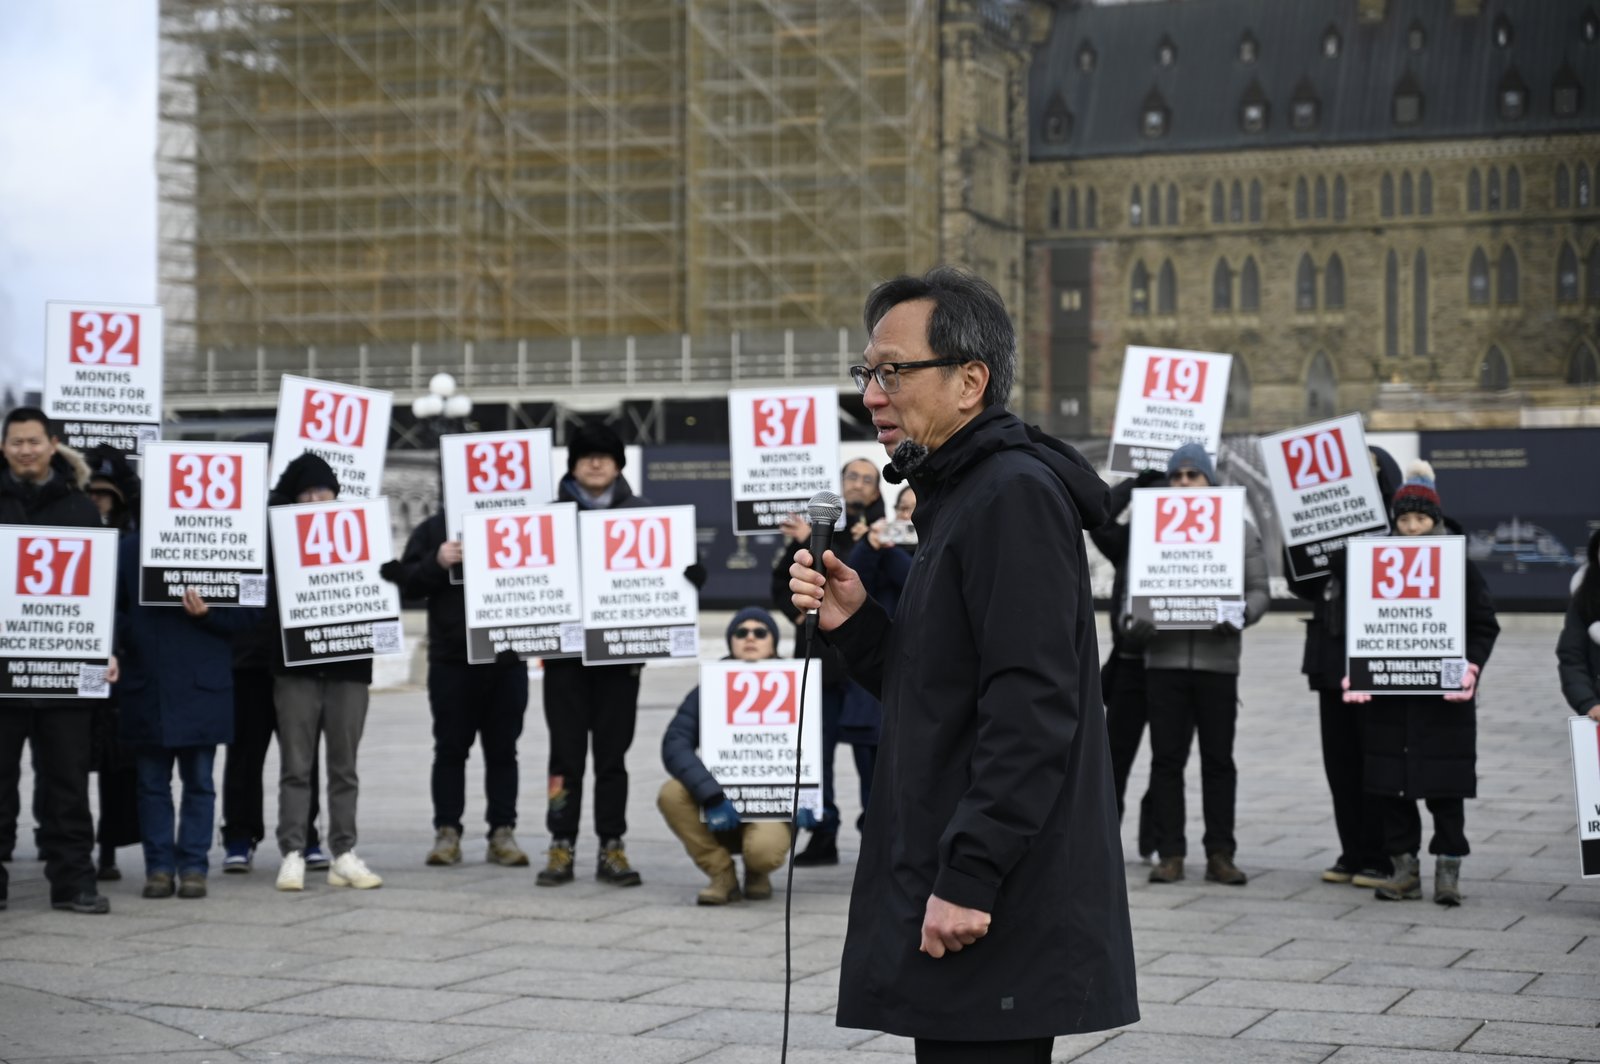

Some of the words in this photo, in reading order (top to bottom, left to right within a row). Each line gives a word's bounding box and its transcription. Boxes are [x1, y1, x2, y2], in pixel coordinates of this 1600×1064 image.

[76, 312, 133, 364] 32
[76, 371, 130, 382] MONTHS
[1149, 359, 1200, 401] 19
[61, 386, 115, 398] WAITING
[121, 388, 144, 399] FOR
[53, 401, 80, 412] IRCC
[84, 403, 152, 415] RESPONSE
[1146, 406, 1194, 417] MONTHS
[306, 391, 362, 446] 30
[760, 399, 810, 446] 37
[1132, 418, 1179, 429] WAITING
[1184, 423, 1205, 431] FOR
[64, 423, 80, 434] NO
[83, 424, 139, 436] TIMELINES
[1123, 430, 1143, 438] IRCC
[69, 436, 84, 447] NO
[761, 453, 810, 463] MONTHS
[1129, 447, 1145, 458] NO
[1131, 459, 1147, 469] NO
[1289, 431, 1343, 488] 20
[472, 442, 525, 492] 33
[749, 469, 797, 478] WAITING
[802, 467, 824, 475] FOR
[342, 469, 365, 480] FOR
[175, 454, 234, 509] 38
[769, 481, 831, 492] RESPONSE
[340, 485, 370, 497] ONSE
[1301, 485, 1350, 505] MONTHS
[475, 497, 526, 509] MONTHS
[753, 502, 768, 513] NO
[1293, 504, 1341, 522] WAITING
[1344, 497, 1367, 510] FOR
[175, 516, 232, 528] MONTHS
[758, 514, 773, 525] NO
[1161, 497, 1215, 543] 23
[1290, 525, 1316, 538] IRCC
[1317, 509, 1377, 532] RESPONSE
[160, 532, 217, 544] WAITING
[221, 532, 247, 544] FOR
[304, 511, 362, 565] 40
[494, 516, 549, 568] 31
[610, 519, 666, 569] 20
[151, 548, 180, 560] IRCC
[184, 549, 255, 561] RESPONSE
[1161, 551, 1213, 559] MONTHS
[1306, 544, 1321, 556] NO
[24, 539, 84, 595] 37
[1313, 556, 1328, 567] NO
[1147, 565, 1199, 575] WAITING
[1203, 565, 1227, 573] FOR
[1378, 548, 1434, 598] 34
[164, 571, 181, 583] NO
[183, 571, 241, 584] TIMELINES
[308, 571, 364, 586] MONTHS
[496, 575, 549, 588] MONTHS
[612, 577, 665, 589] MONTHS
[1140, 579, 1166, 588] IRCC
[1168, 579, 1233, 588] RESPONSE
[168, 585, 185, 596] NO
[296, 589, 351, 603] WAITING
[355, 585, 380, 597] FOR
[483, 591, 535, 604] WAITING
[540, 589, 564, 600] FOR
[599, 593, 651, 605] WAITING
[656, 592, 679, 602] FOR
[1149, 598, 1166, 609] NO
[22, 604, 80, 617] MONTHS
[290, 608, 318, 620] IRCC
[321, 600, 389, 617] RESPONSE
[476, 609, 503, 620] IRCC
[506, 604, 572, 618] RESPONSE
[591, 611, 618, 621] IRCC
[621, 607, 687, 619] RESPONSE
[1153, 610, 1170, 621] NO
[1171, 610, 1217, 621] RESULTS
[1378, 608, 1433, 618] MONTHS
[6, 621, 64, 633] WAITING
[68, 622, 94, 634] FOR
[304, 628, 321, 641] NO
[323, 623, 373, 639] TIMELINE
[488, 629, 505, 641] NO
[506, 625, 561, 640] TIMELINES
[1364, 623, 1418, 634] WAITING
[1422, 623, 1447, 633] FOR
[604, 630, 620, 642] NO
[622, 628, 670, 641] TIMELINE
[0, 638, 27, 649] RCC
[29, 638, 101, 652] RESPONSE
[311, 641, 327, 654] NO
[494, 641, 510, 653] NO
[511, 638, 559, 652] RESULTS
[609, 643, 624, 655] NO
[1357, 640, 1384, 649] IRCC
[1387, 638, 1455, 649] RESPONSE
[8, 661, 24, 673] NO
[1368, 660, 1384, 672] NO
[1386, 660, 1441, 672] TIMELINES
[12, 676, 28, 688] NO
[1373, 674, 1389, 685] NO
[1391, 673, 1437, 685] RESULTS
[733, 672, 790, 724] 22
[732, 734, 789, 744] MONTHS
[718, 750, 773, 761] WAITING
[742, 787, 796, 800] TIMELINE
